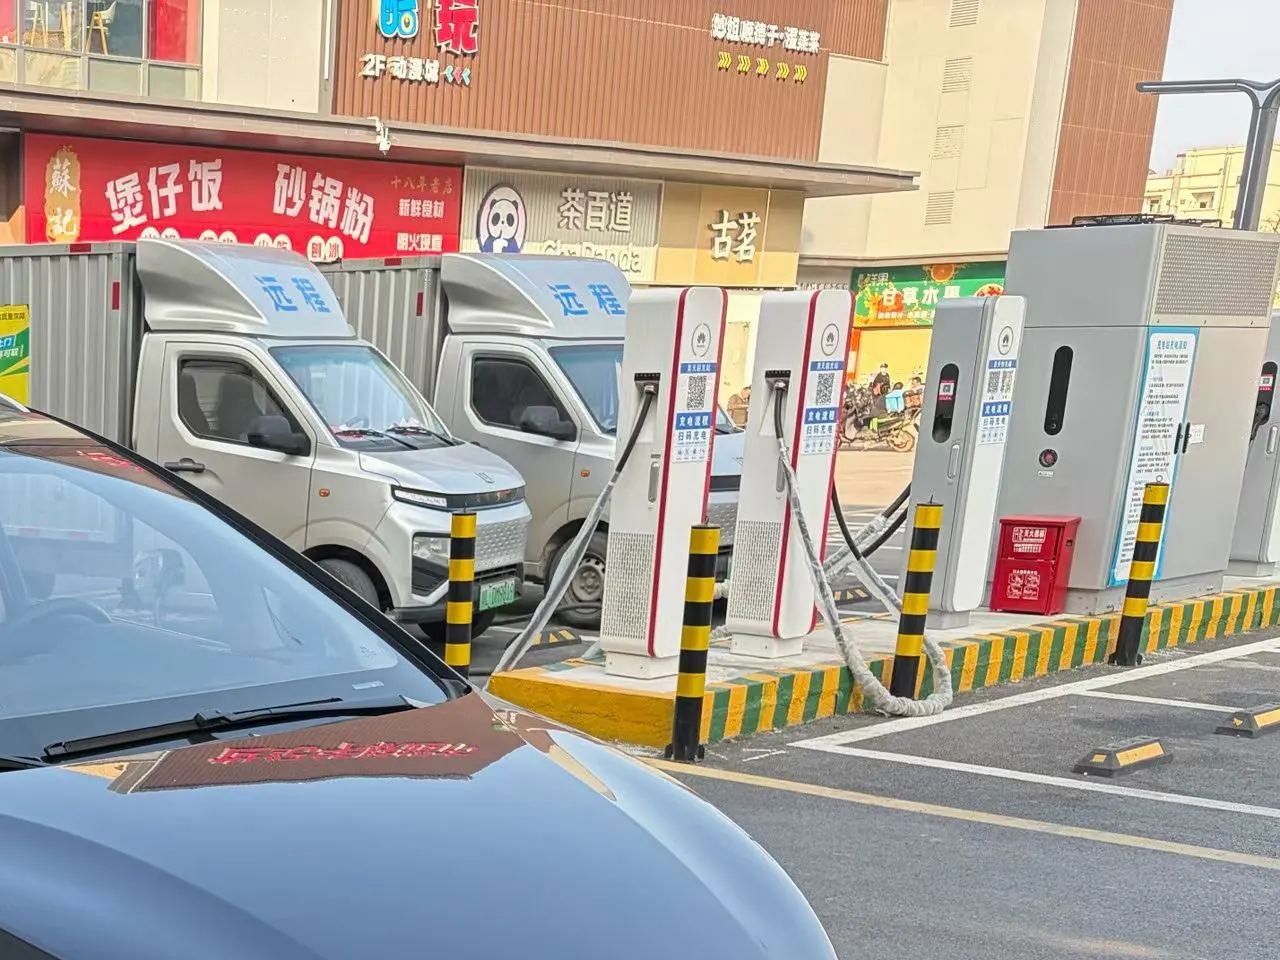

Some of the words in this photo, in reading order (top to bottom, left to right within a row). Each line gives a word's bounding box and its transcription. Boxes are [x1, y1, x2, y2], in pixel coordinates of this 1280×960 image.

[360, 53, 386, 78] 2F
[387, 55, 440, 83] 动漫城
[104, 157, 224, 235] 煲仔饭
[271, 162, 376, 245] 砂锅粉
[399, 199, 445, 218] 新鲜食材
[558, 188, 633, 233] 茶百道
[709, 210, 762, 264] 古茗
[253, 275, 332, 312] 远程
[546, 283, 626, 316] 远程
